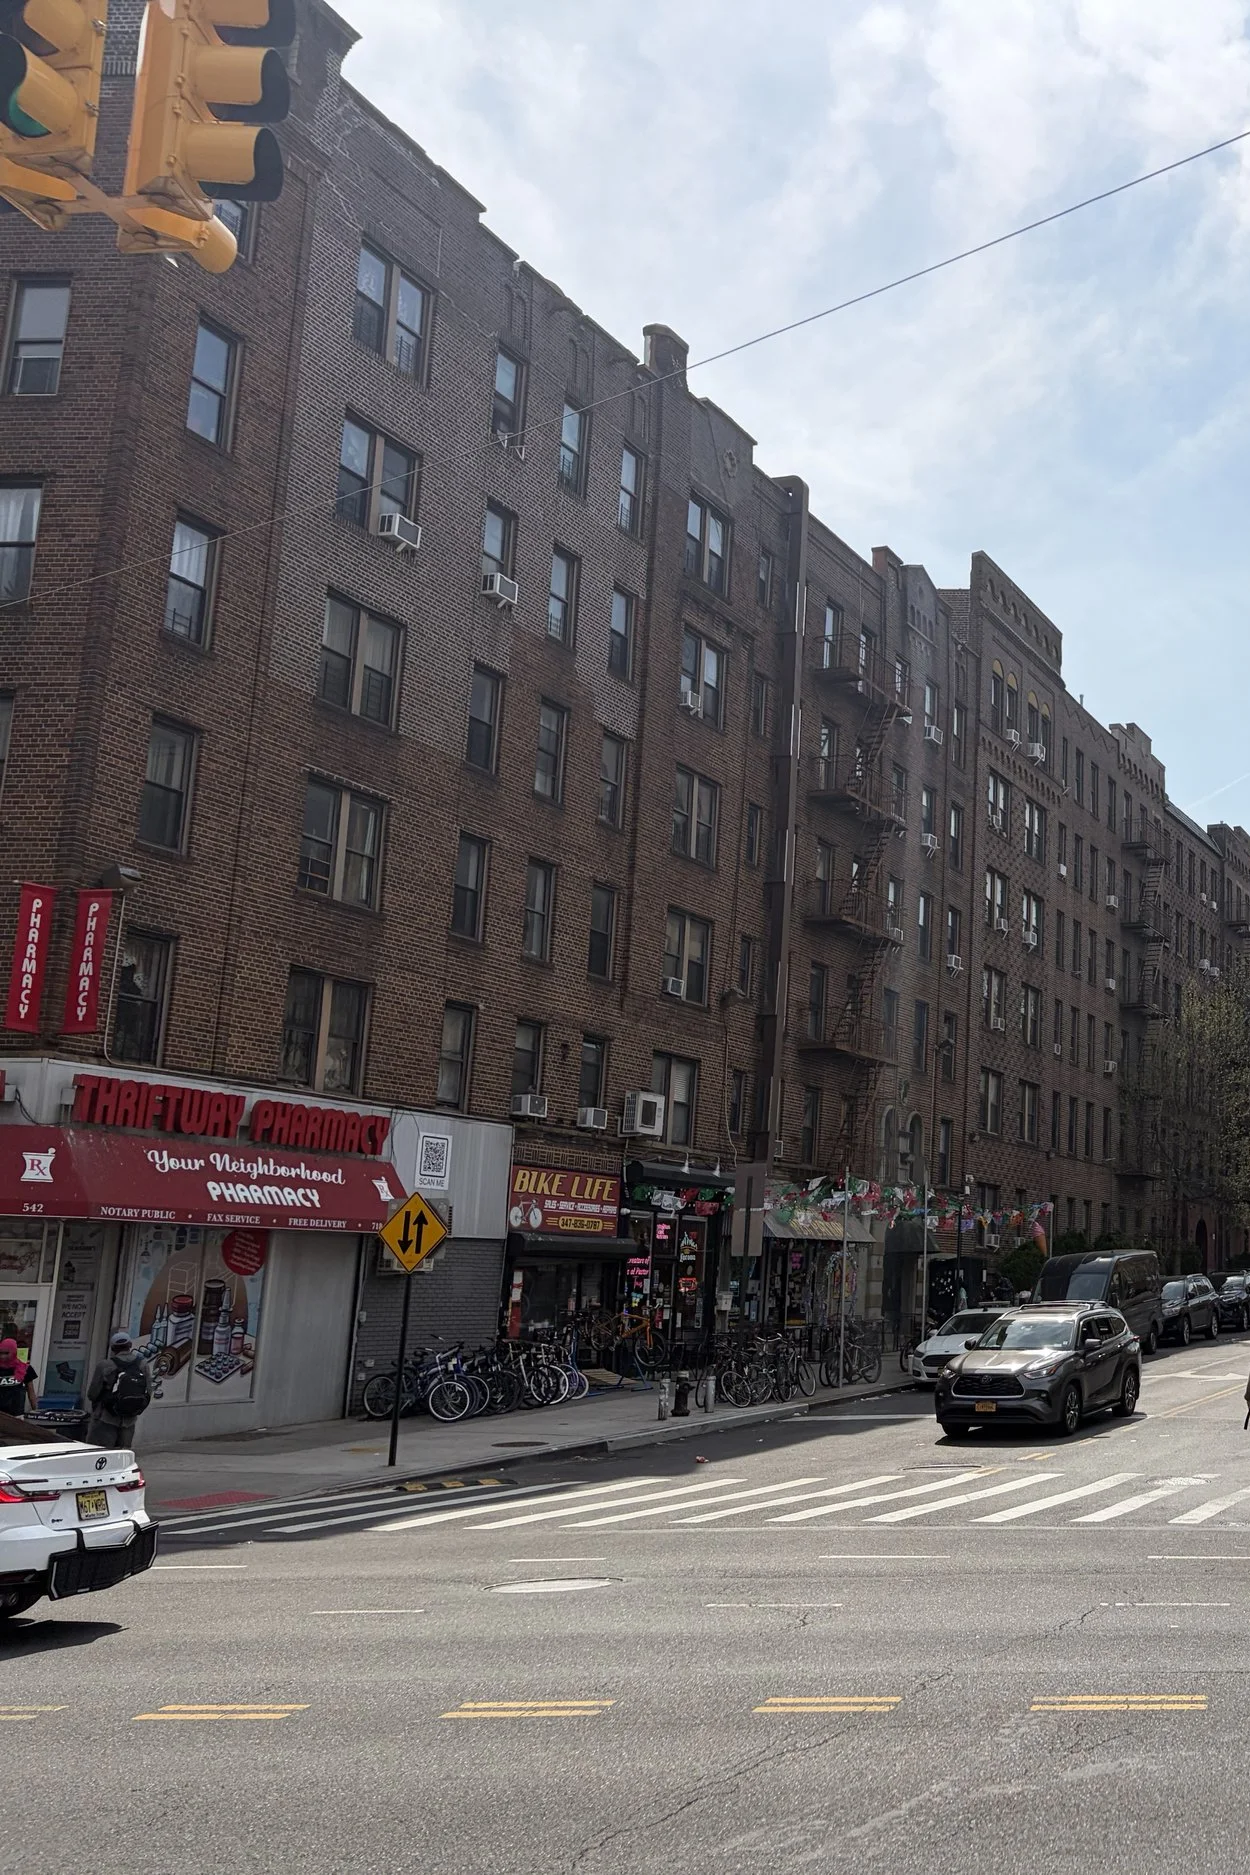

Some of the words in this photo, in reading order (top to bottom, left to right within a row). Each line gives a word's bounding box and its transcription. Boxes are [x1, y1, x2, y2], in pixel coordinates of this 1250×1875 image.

[19, 899, 42, 1019] PHARMACY
[77, 903, 99, 1021] PHARMACY
[72, 1073, 246, 1138] THRIFTWAY
[250, 1099, 391, 1155] PHARMACY
[147, 1150, 205, 1173] Your
[209, 1152, 346, 1185] Neighborhood
[419, 1177, 435, 1186] SCAN
[435, 1179, 445, 1187] ME
[206, 1181, 321, 1208] PHARMACY
[513, 1169, 568, 1196] BIKE
[570, 1176, 617, 1201] LIFE
[22, 1202, 44, 1213] 542
[100, 1206, 139, 1217] NOTARY
[141, 1209, 176, 1219] PUBLIC
[207, 1213, 224, 1222] FAX
[225, 1214, 261, 1224] SERVICE
[288, 1217, 309, 1227] FREE
[310, 1218, 348, 1229] DELIVERY
